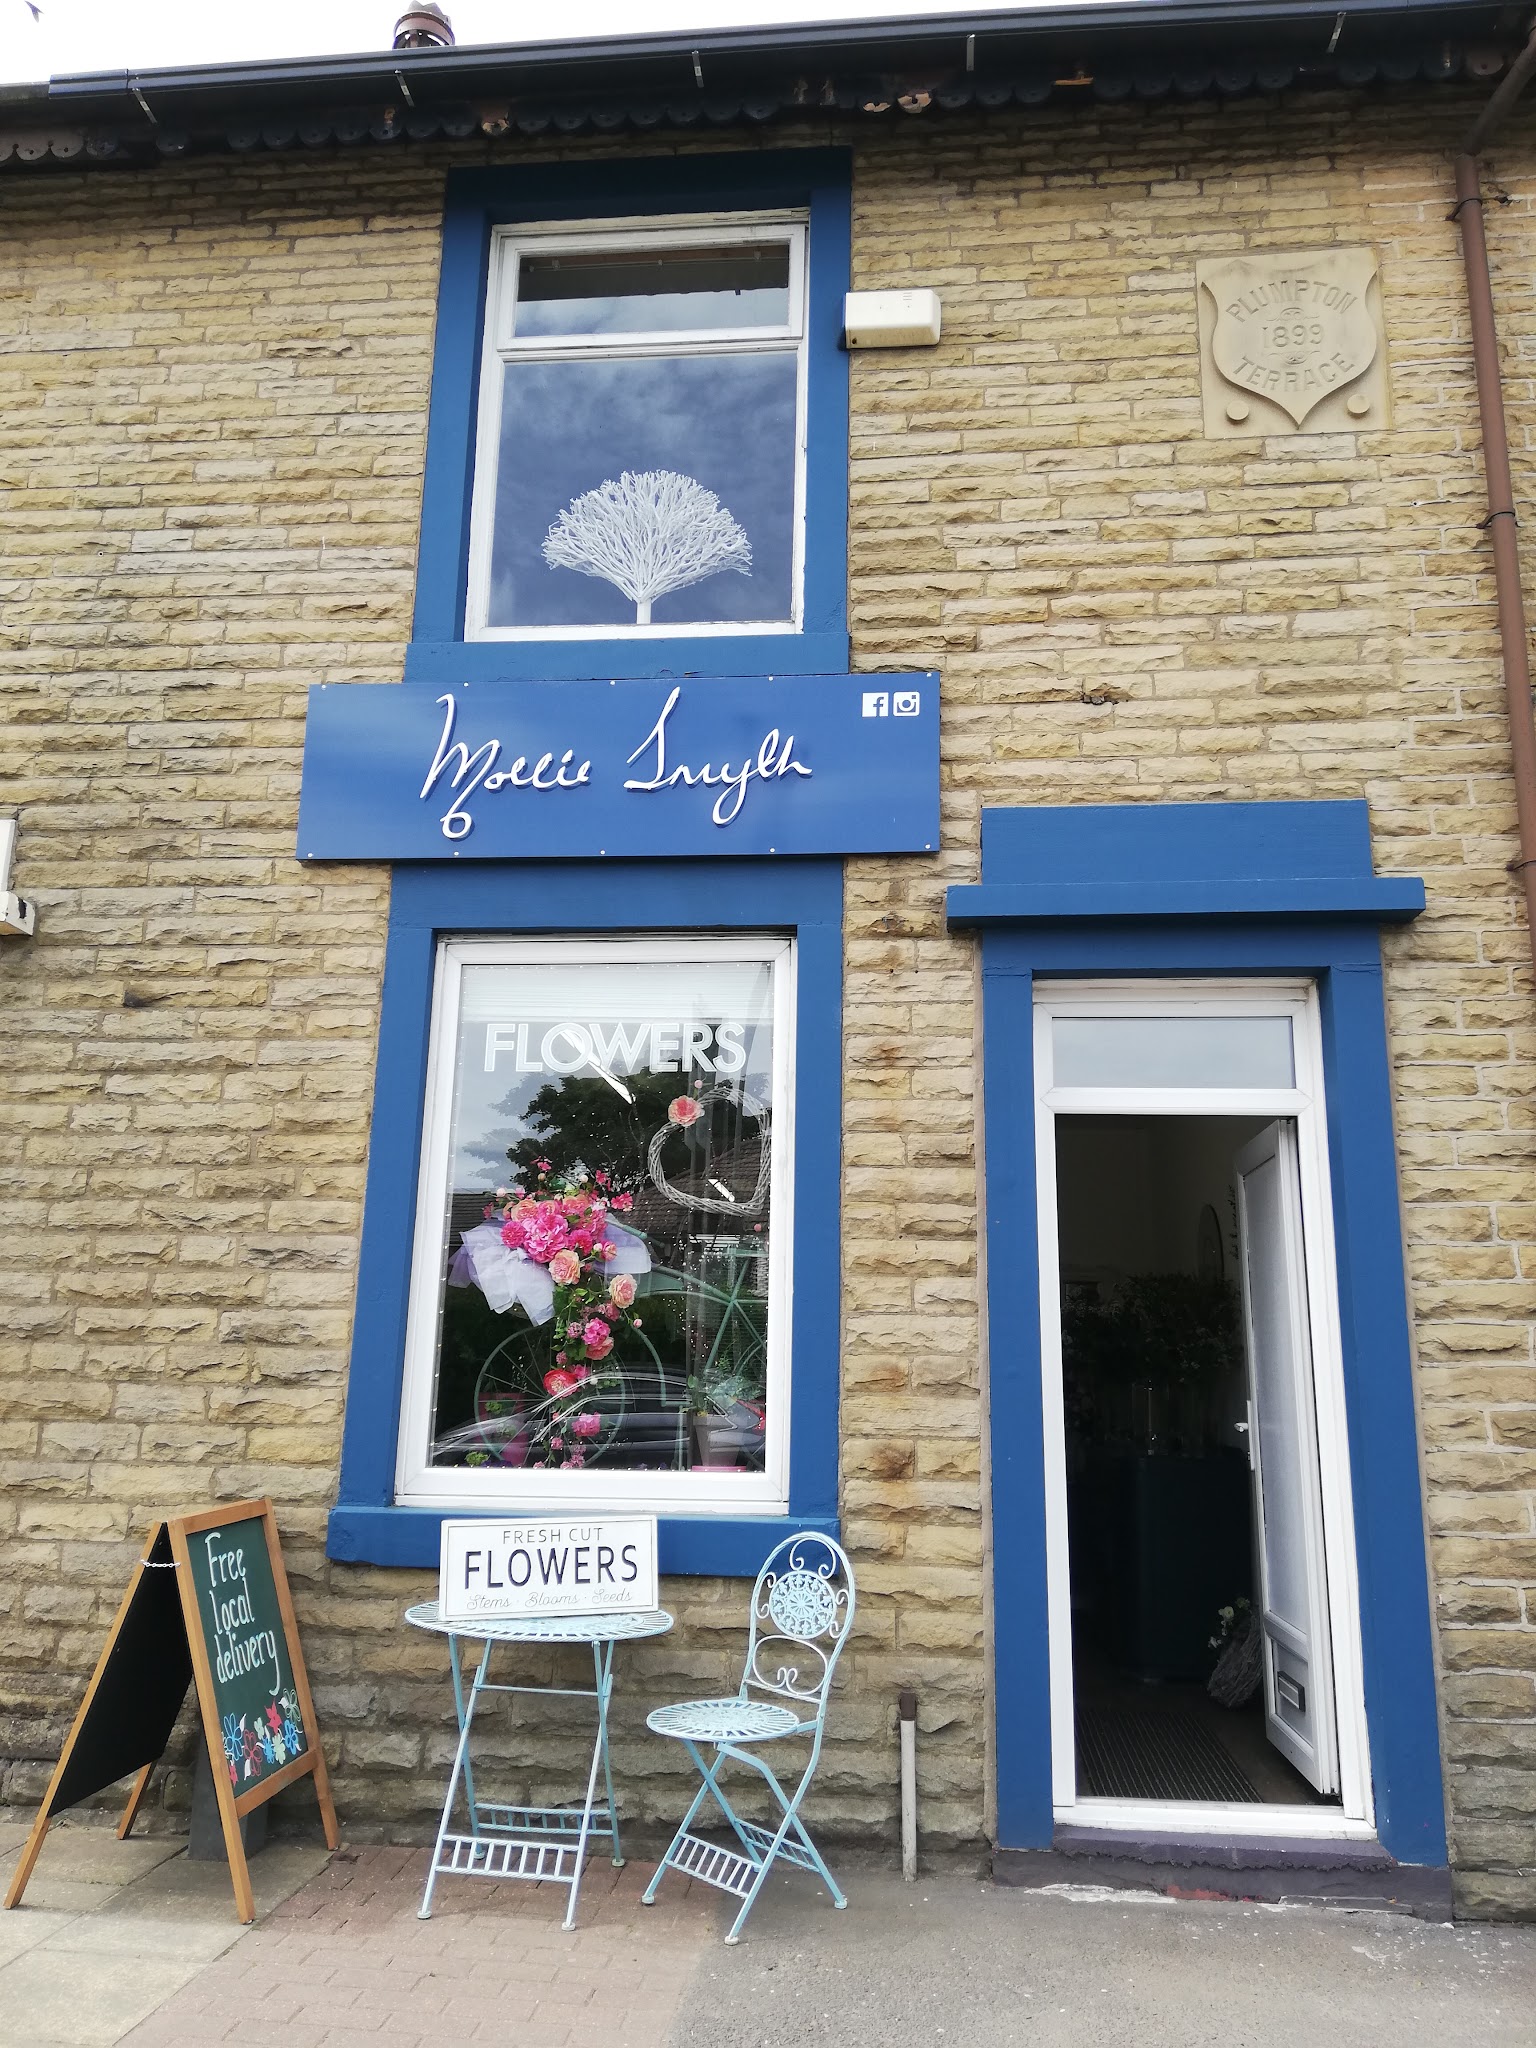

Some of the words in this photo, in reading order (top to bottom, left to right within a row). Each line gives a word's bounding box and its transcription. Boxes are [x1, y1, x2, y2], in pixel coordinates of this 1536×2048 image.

[1226, 279, 1358, 323] PLUMPTON
[1262, 323, 1324, 348] 1899
[1232, 352, 1356, 393] TERRACE
[419, 693, 591, 839] Mollie
[623, 686, 813, 825] Smyth
[484, 1022, 746, 1074] FLOWERS
[503, 1528, 562, 1544] FRESH
[568, 1527, 604, 1542] CUT
[204, 1531, 247, 1588] Free
[464, 1544, 638, 1590] FLOWERS
[209, 1577, 256, 1636] local
[466, 1593, 512, 1610] Stems
[524, 1591, 581, 1608] Blooms
[591, 1587, 633, 1604] Seeds
[214, 1629, 281, 1697] delivery
